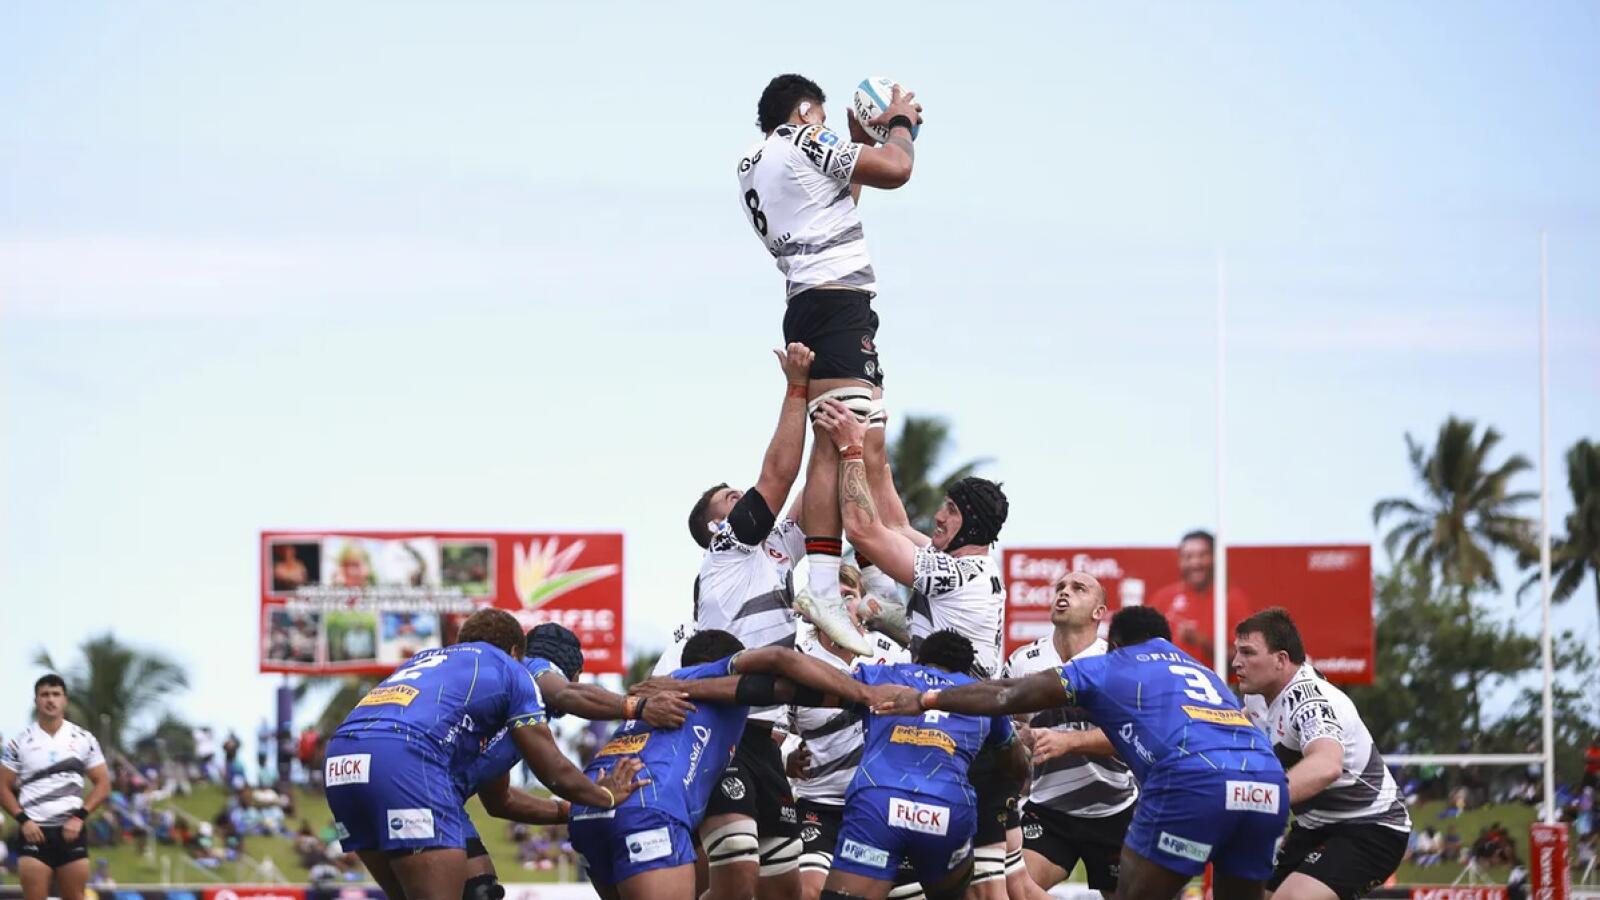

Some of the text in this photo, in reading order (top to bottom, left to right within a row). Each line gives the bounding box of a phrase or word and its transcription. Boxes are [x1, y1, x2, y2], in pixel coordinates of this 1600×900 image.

[744, 188, 768, 237] 8
[387, 653, 448, 683] 2
[1168, 665, 1223, 705] 3
